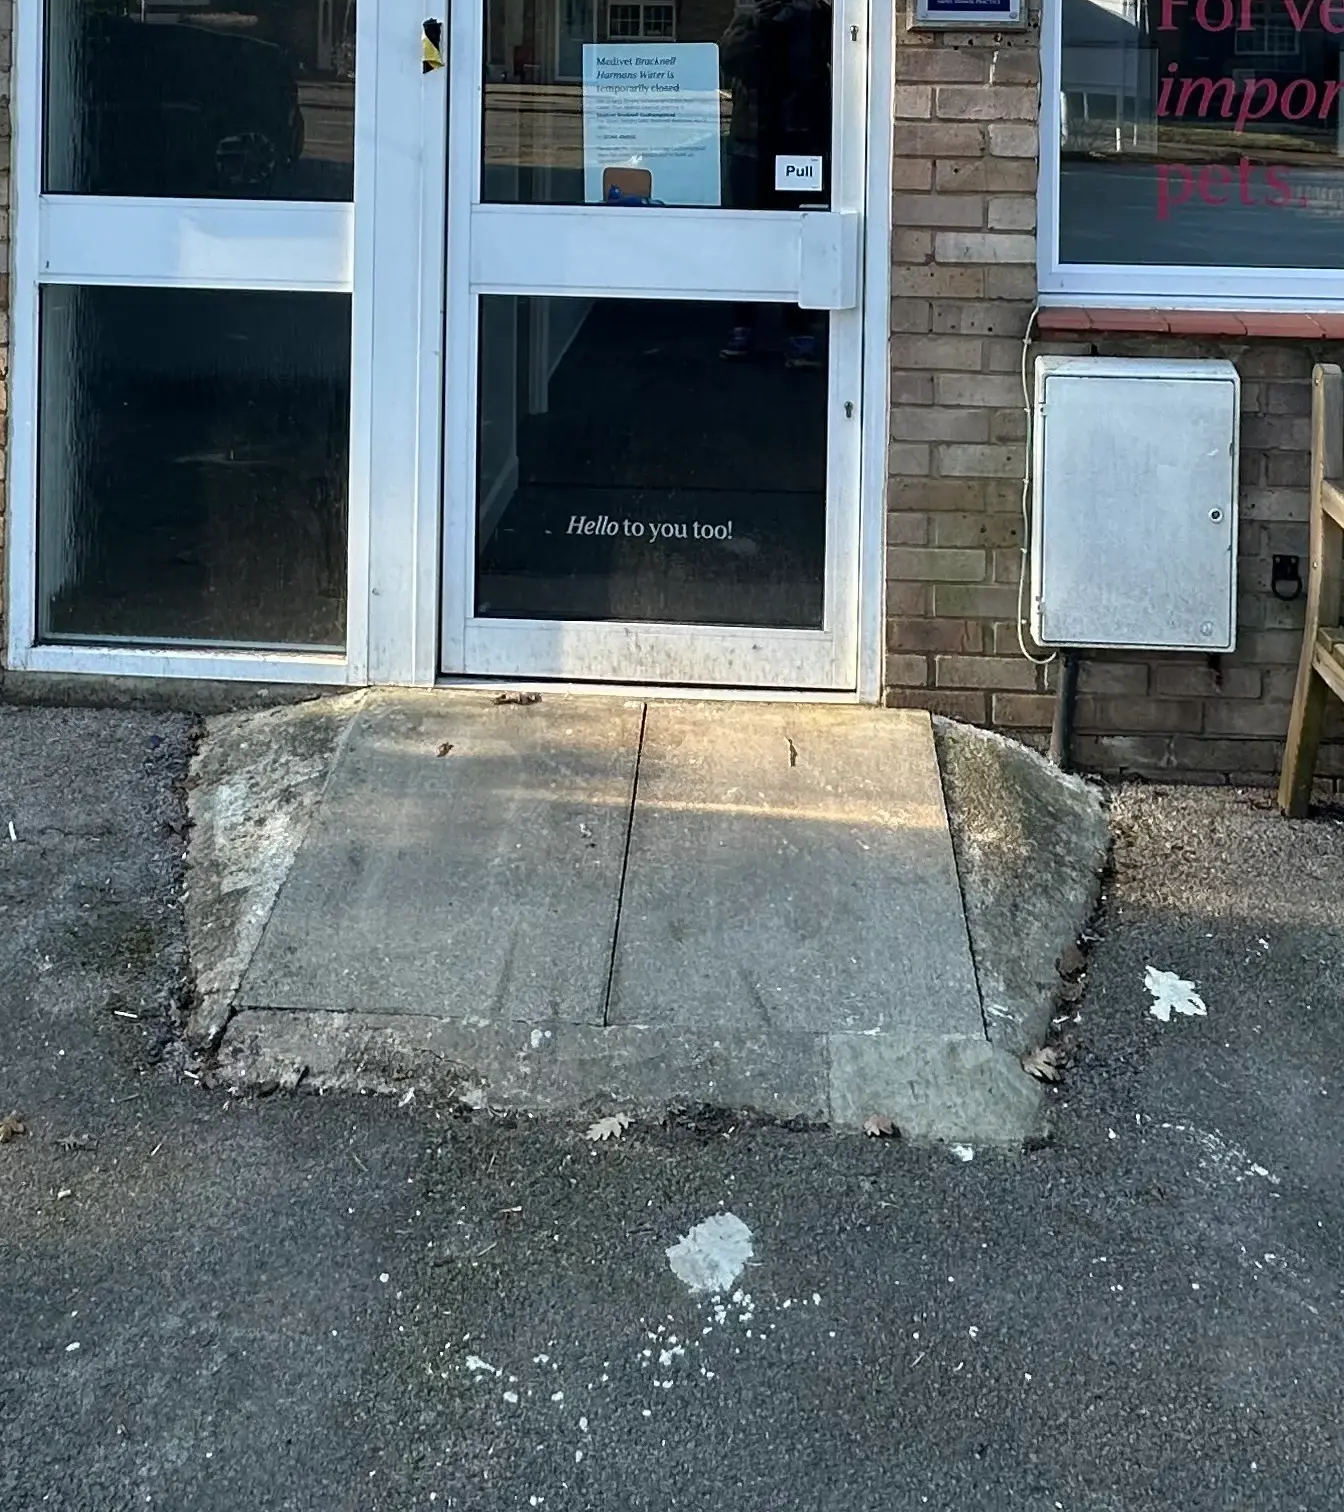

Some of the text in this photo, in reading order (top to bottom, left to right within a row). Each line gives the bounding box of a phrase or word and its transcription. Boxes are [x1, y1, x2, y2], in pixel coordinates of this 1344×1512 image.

[596, 56, 677, 67] Medivet Bracknell
[666, 70, 675, 80] is
[596, 83, 680, 95] temporarily closed
[785, 165, 813, 178] Pull
[1157, 155, 1311, 221] pets.
[566, 515, 733, 543] Hello to you too!
